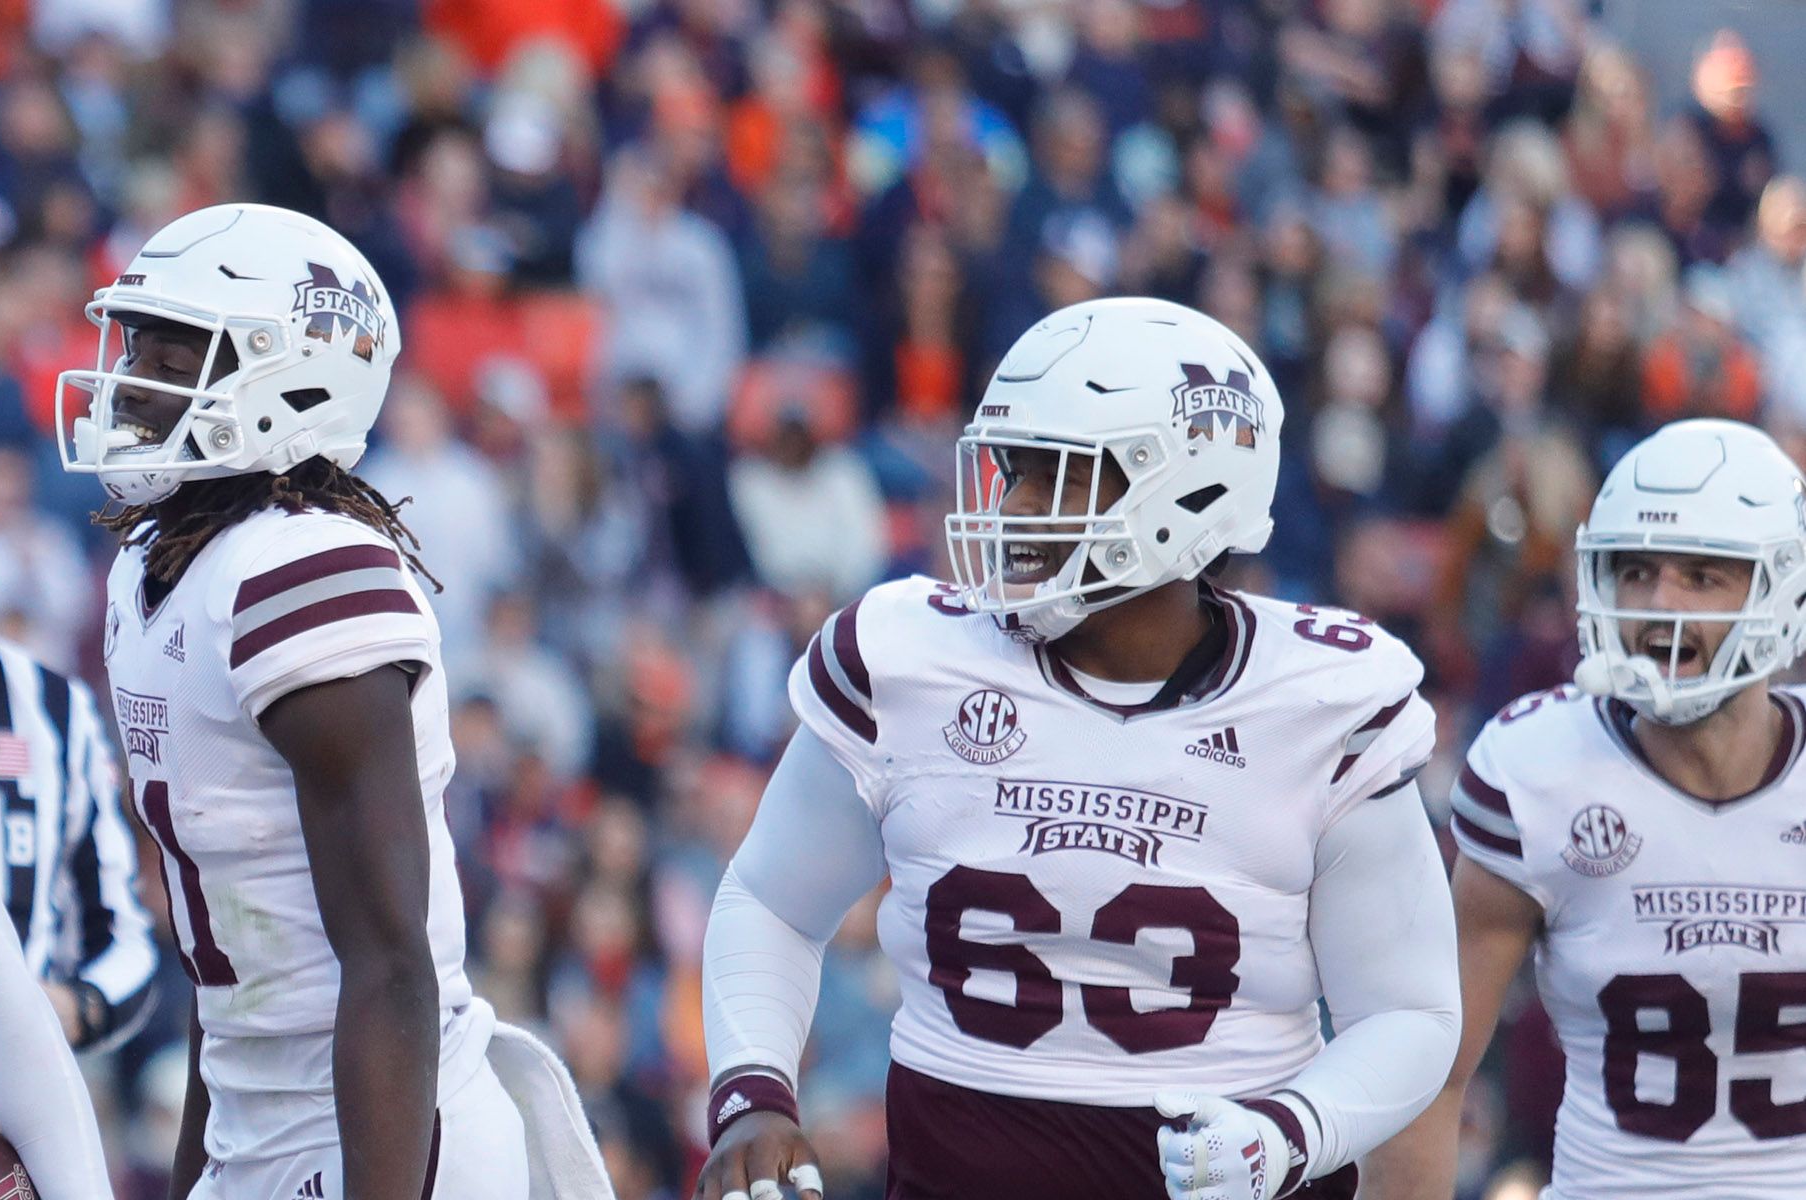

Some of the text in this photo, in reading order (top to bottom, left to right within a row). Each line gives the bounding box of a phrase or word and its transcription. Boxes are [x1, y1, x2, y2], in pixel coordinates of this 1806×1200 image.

[313, 290, 373, 332] STATE
[1191, 388, 1253, 419] STATE
[959, 690, 1017, 746] SEC
[951, 737, 1014, 763] GRADUATE
[1184, 743, 1247, 769] adidas
[994, 781, 1208, 837] MISSISSIPPI
[1042, 825, 1142, 860] STATE
[1571, 805, 1626, 858] SEC
[1633, 891, 1806, 916] MISSISSIPPI
[1682, 920, 1761, 946] STATE
[925, 863, 1241, 1055] 63
[1596, 971, 1806, 1143] 85
[717, 1100, 752, 1124] adidas
